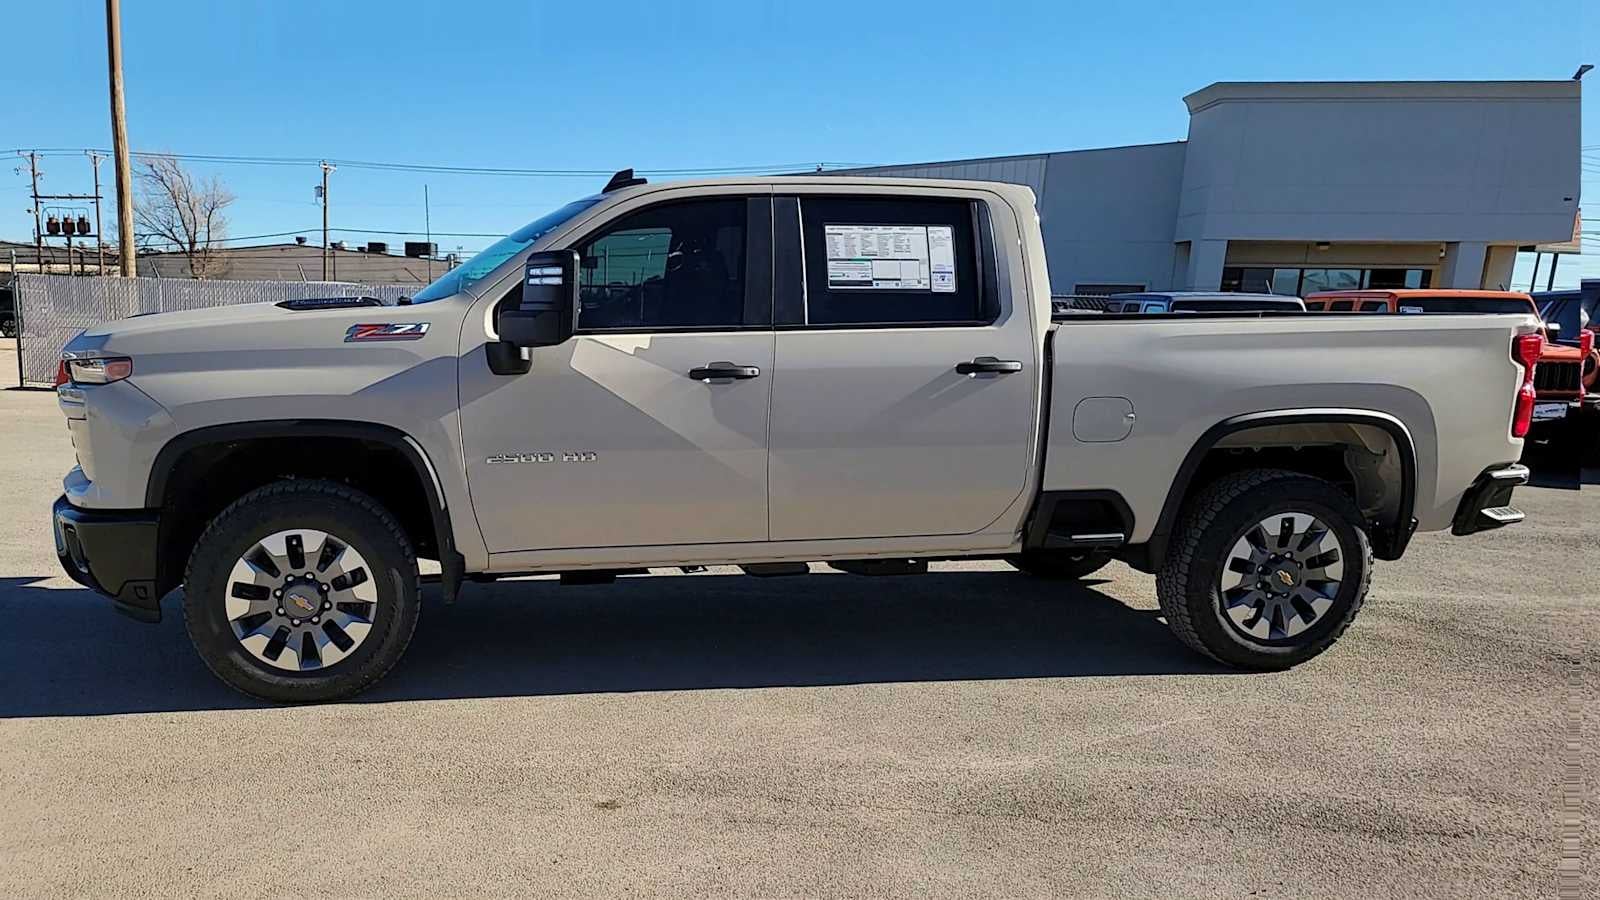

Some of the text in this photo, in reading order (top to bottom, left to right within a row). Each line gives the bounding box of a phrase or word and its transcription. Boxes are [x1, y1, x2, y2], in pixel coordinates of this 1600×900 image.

[346, 323, 431, 341] Z71
[486, 452, 598, 464] 2500 HD
